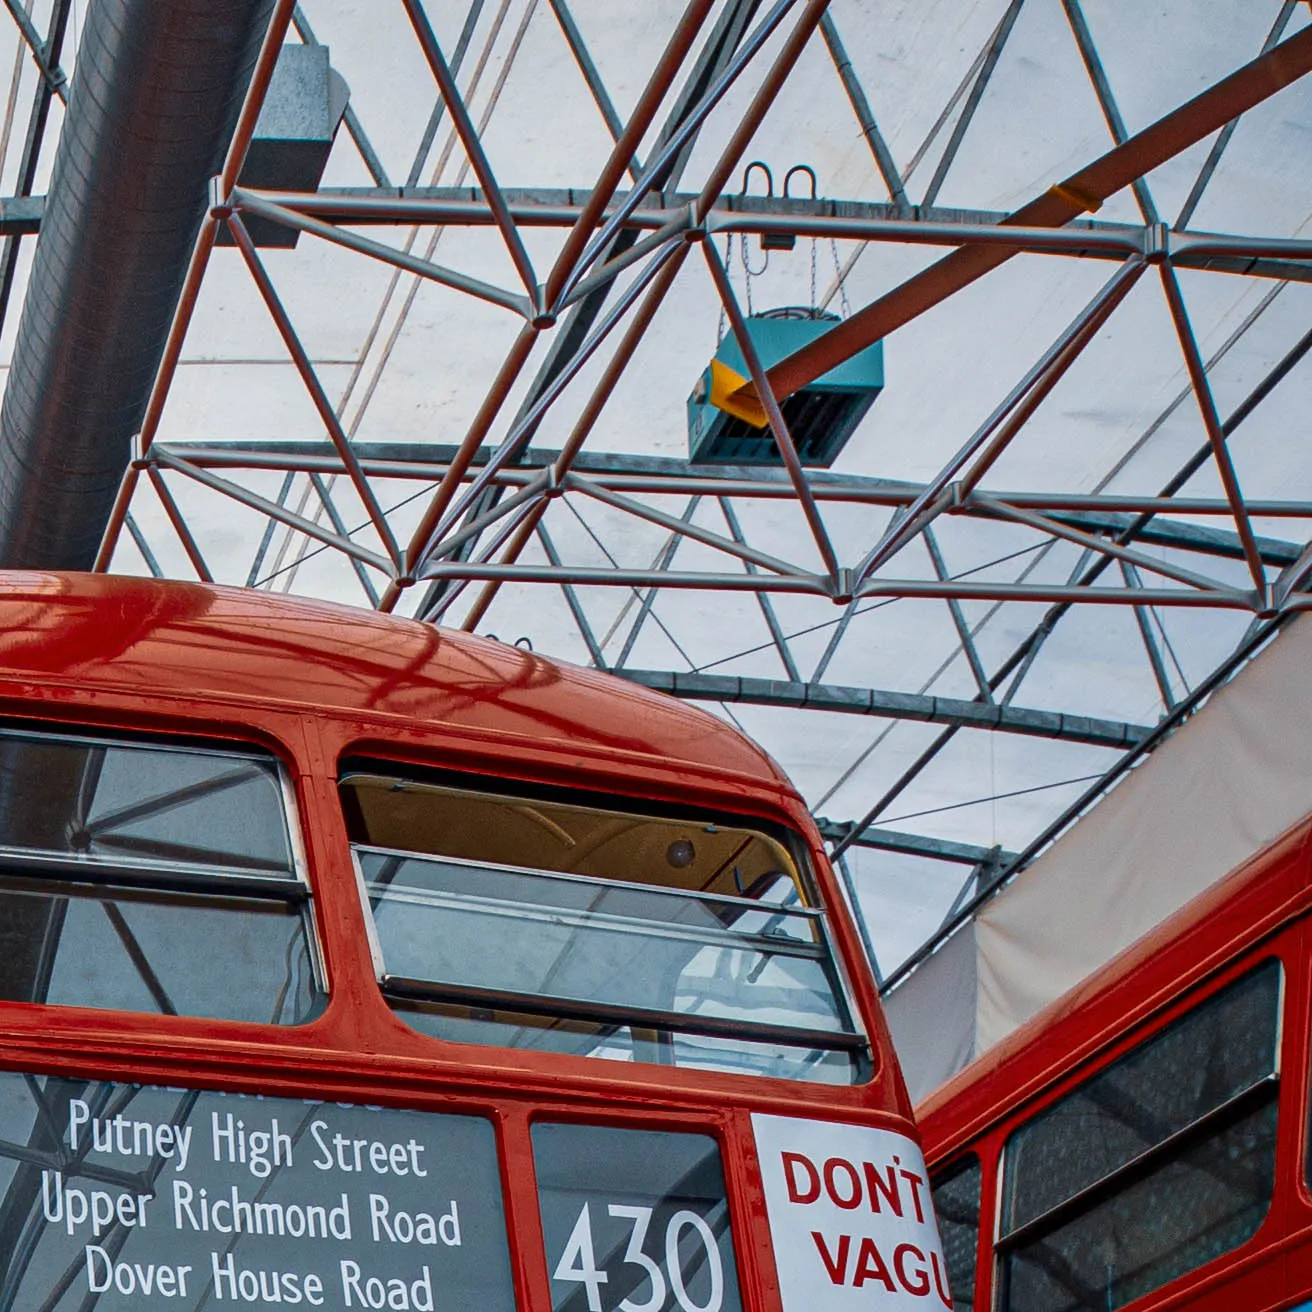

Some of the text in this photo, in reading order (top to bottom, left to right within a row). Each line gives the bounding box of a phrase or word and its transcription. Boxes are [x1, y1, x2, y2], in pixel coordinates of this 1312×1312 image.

[69, 1099, 427, 1177] Putney High Street
[42, 1170, 462, 1246] Upper Richmond Road
[781, 1151, 924, 1224] DON'T
[86, 1245, 434, 1312] Dover House Road
